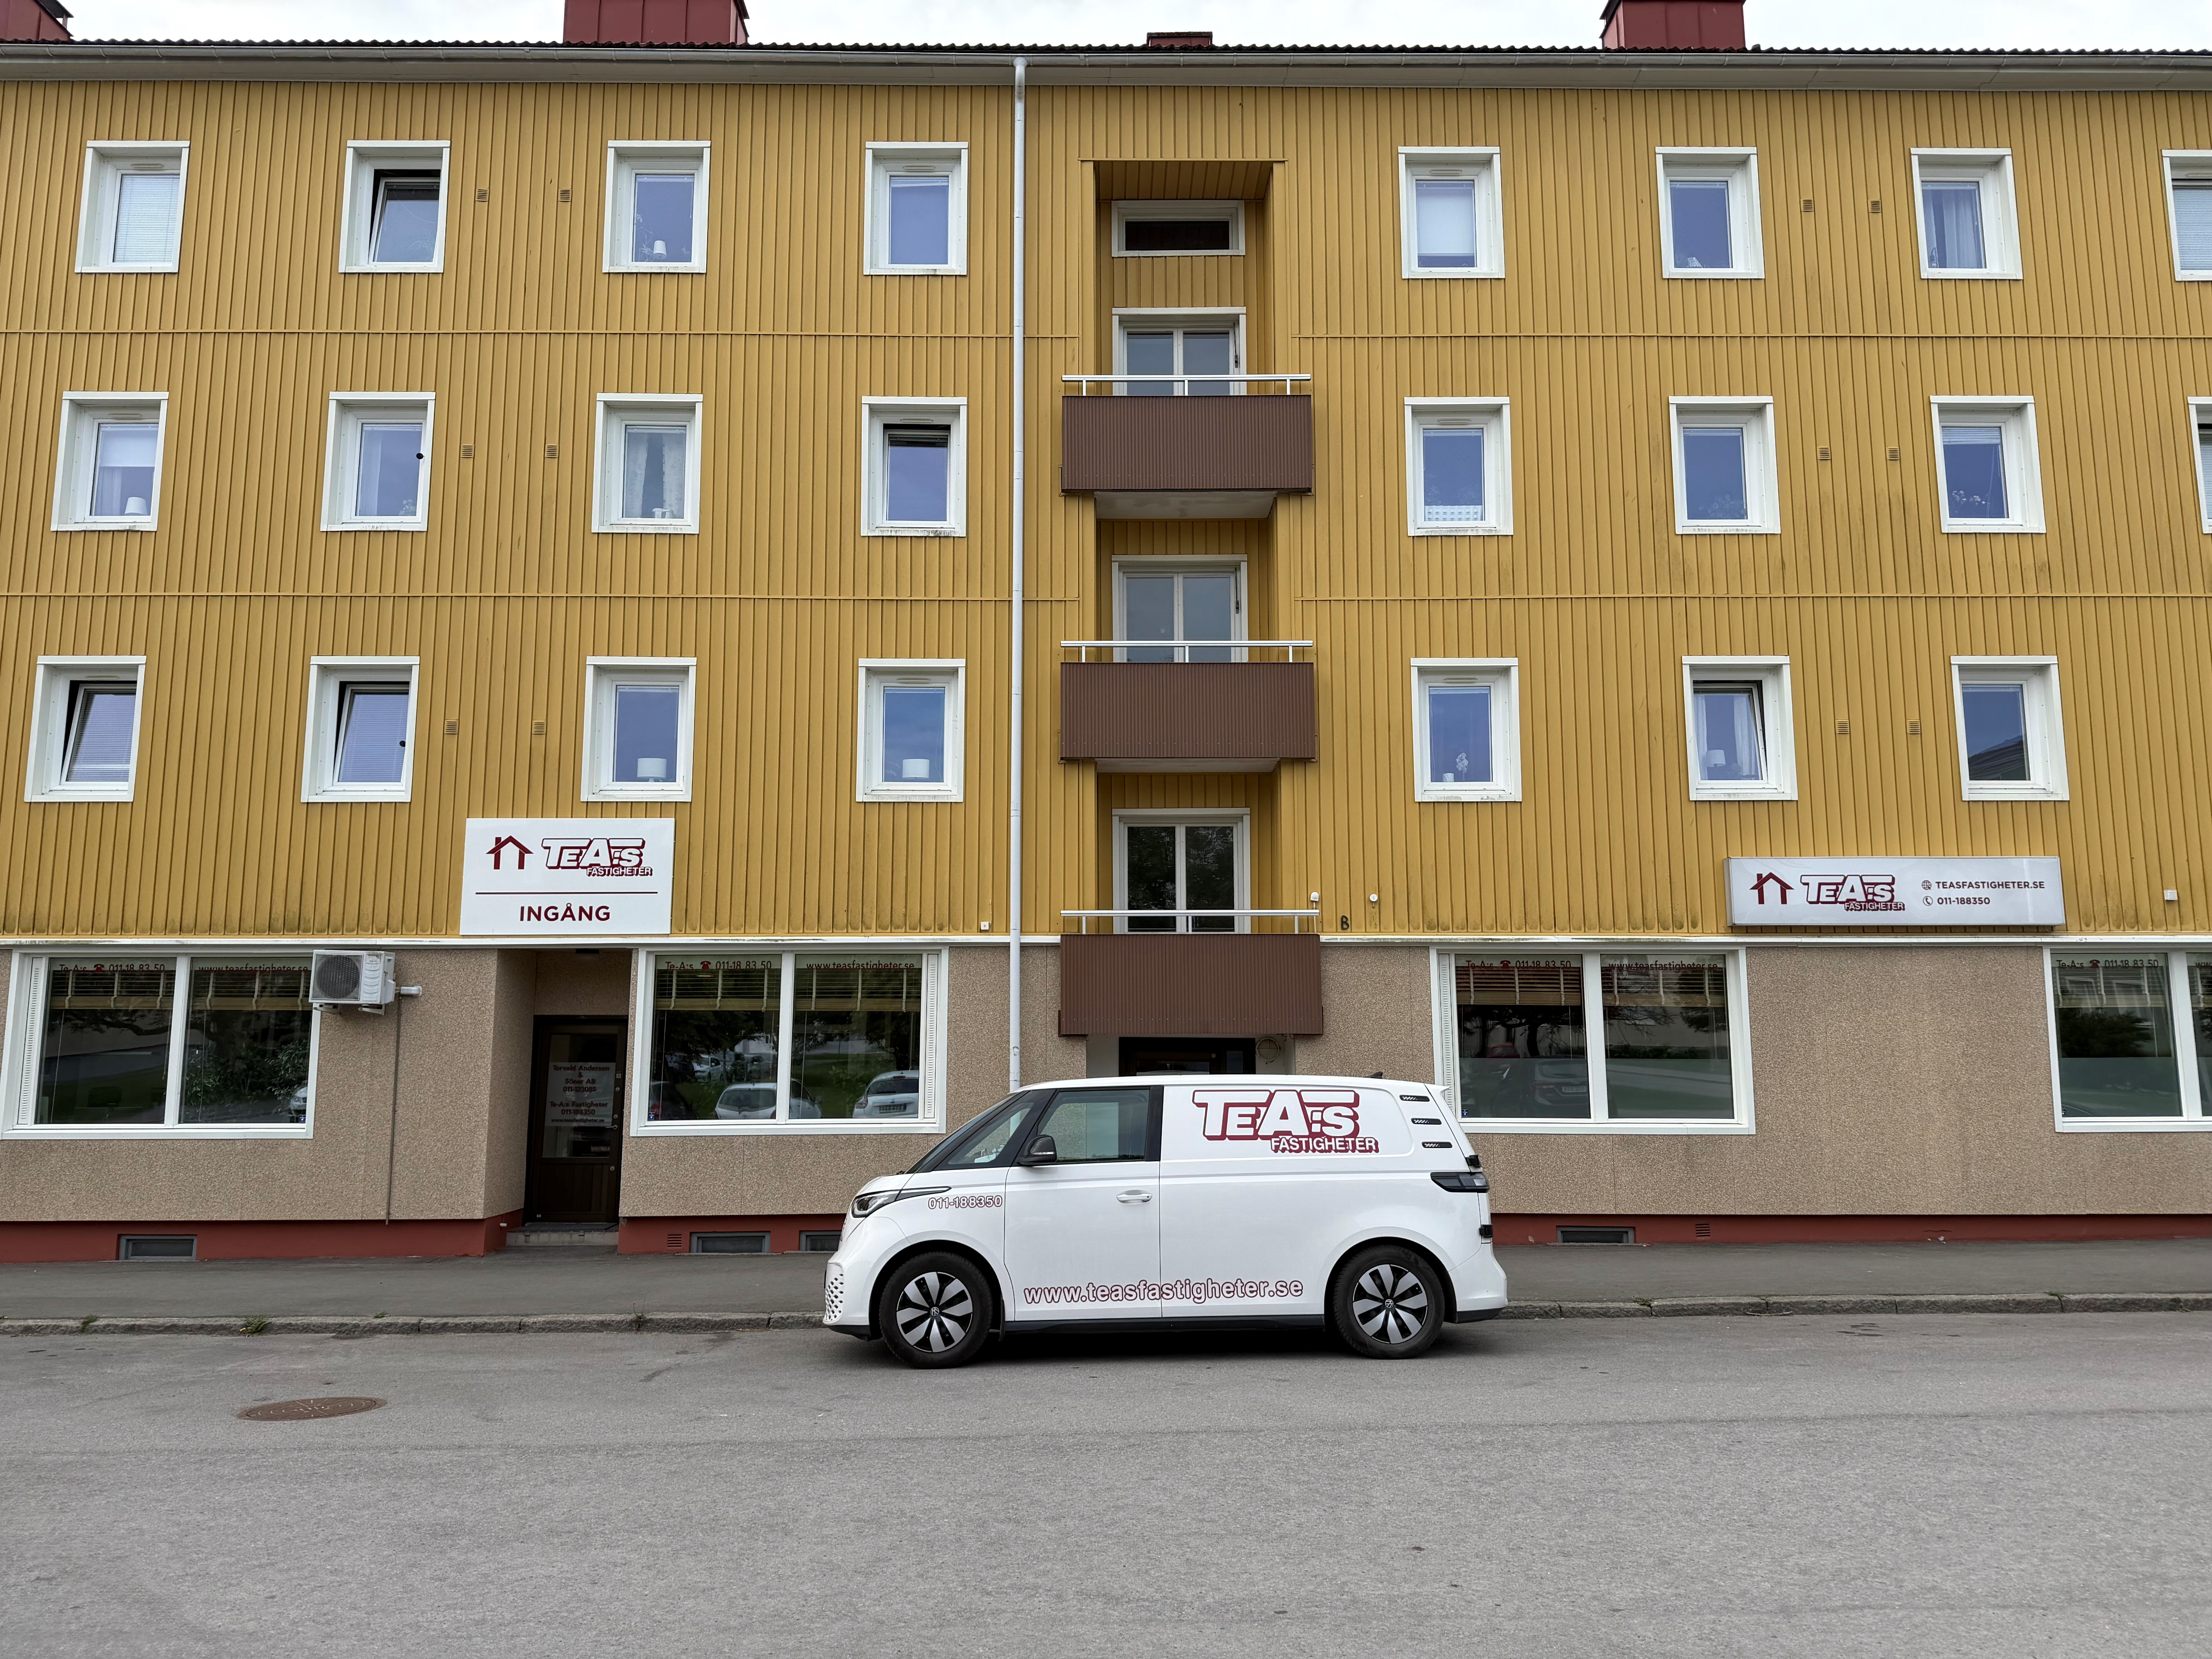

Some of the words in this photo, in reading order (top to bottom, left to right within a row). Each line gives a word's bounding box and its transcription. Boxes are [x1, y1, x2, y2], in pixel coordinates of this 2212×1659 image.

[586, 866, 653, 877] FASTIGHETER
[1936, 881, 2045, 889] TEASFASTIGHETER.SE
[1844, 901, 1905, 912] FASTIGHETER
[1937, 897, 1990, 905] 011-188350
[519, 903, 610, 922] INGÅNG
[1341, 915, 1350, 930] B
[139, 963, 149, 972] 83
[154, 963, 165, 972] 50
[198, 963, 308, 974] wwwteasfastigheterse
[665, 961, 693, 970] Te-A:s
[715, 961, 741, 970] 011-18
[745, 961, 756, 970] 83
[761, 961, 772, 970] 50
[806, 960, 914, 970] wwwteasfastigheterse
[1545, 960, 1556, 969] 83
[1560, 960, 1571, 969] 50
[2056, 960, 2084, 969] Te-A:s
[2104, 959, 2130, 969] 011-18
[2133, 959, 2144, 968] 83
[2148, 959, 2159, 968] 50
[1270, 1137, 1379, 1153] FASTIGHETER
[928, 1195, 1003, 1209] 011-188350
[1023, 1278, 1304, 1304] www.teasfastigheter.se
